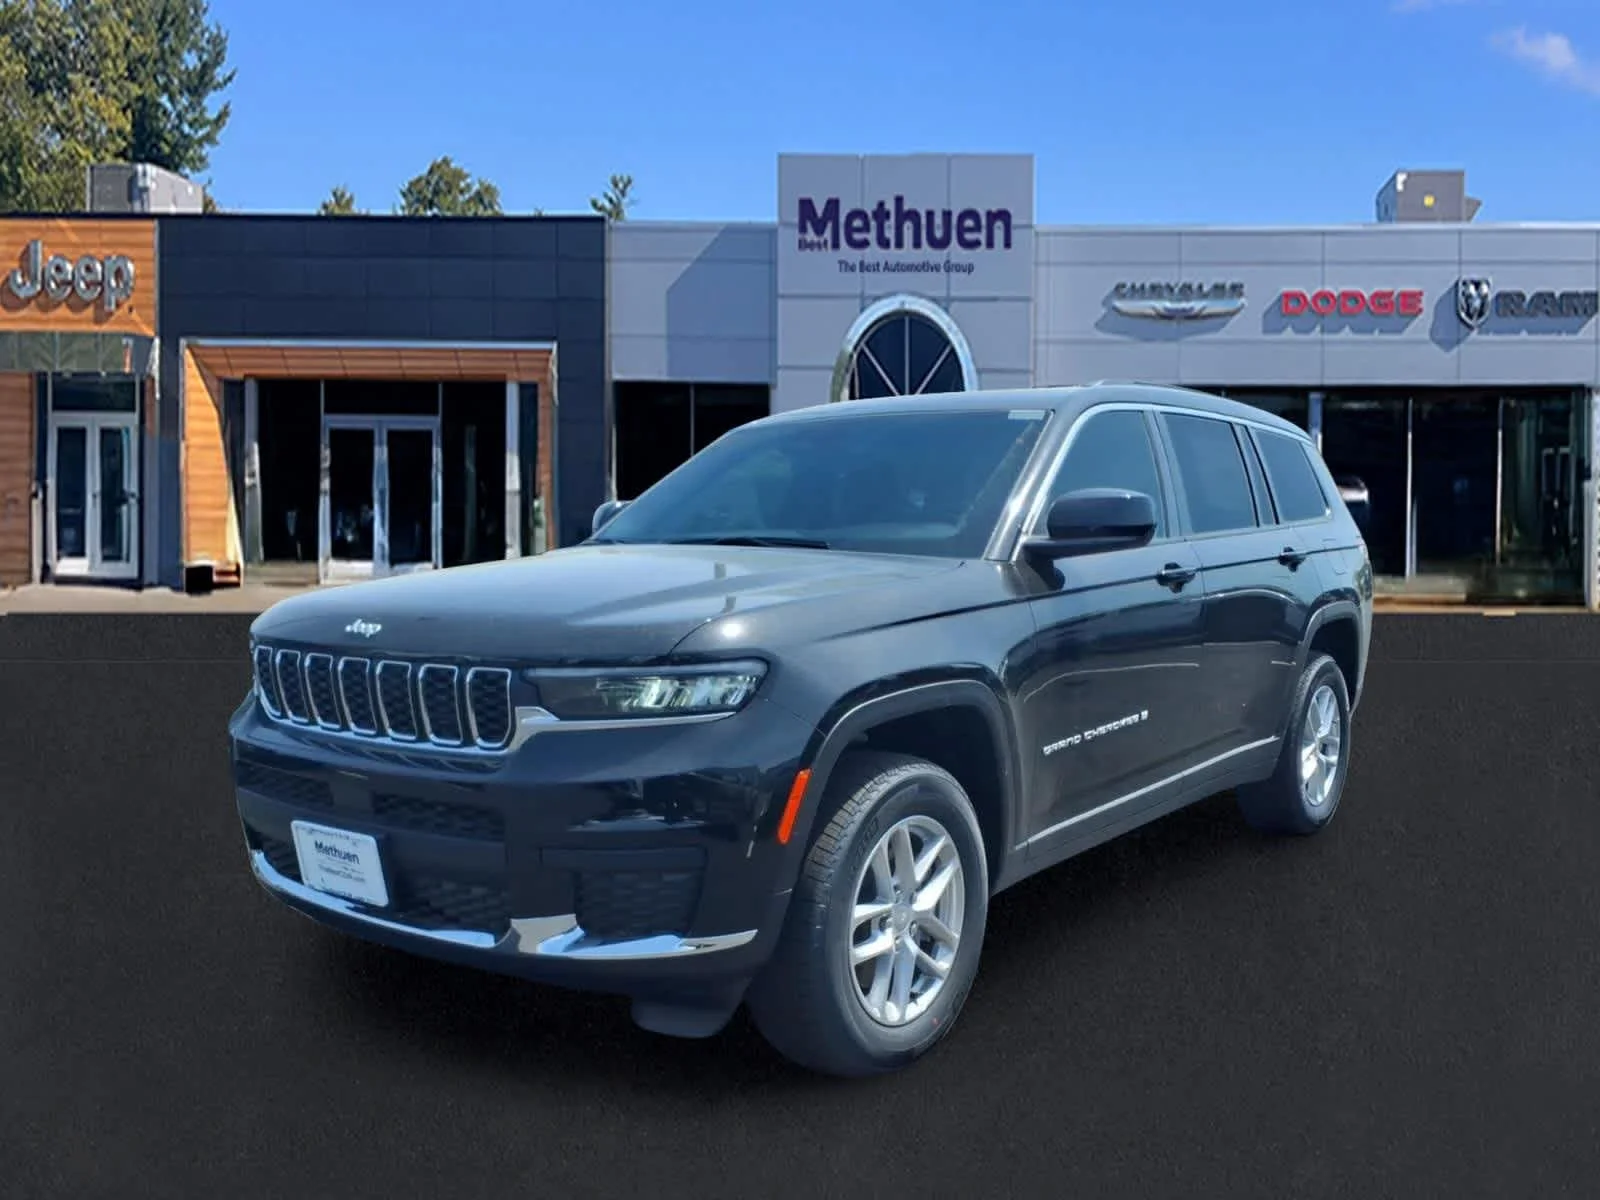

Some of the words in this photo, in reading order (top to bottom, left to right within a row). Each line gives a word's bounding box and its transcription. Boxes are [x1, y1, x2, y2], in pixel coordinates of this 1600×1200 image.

[798, 195, 1013, 250] Methuen
[9, 239, 136, 312] Jeep
[838, 259, 857, 273] The
[859, 259, 881, 273] Best
[883, 259, 941, 273] Automotive
[943, 259, 975, 275] Group
[1281, 289, 1425, 316] DODGE
[1494, 289, 1600, 319] RAM
[314, 839, 361, 865] Methuen
